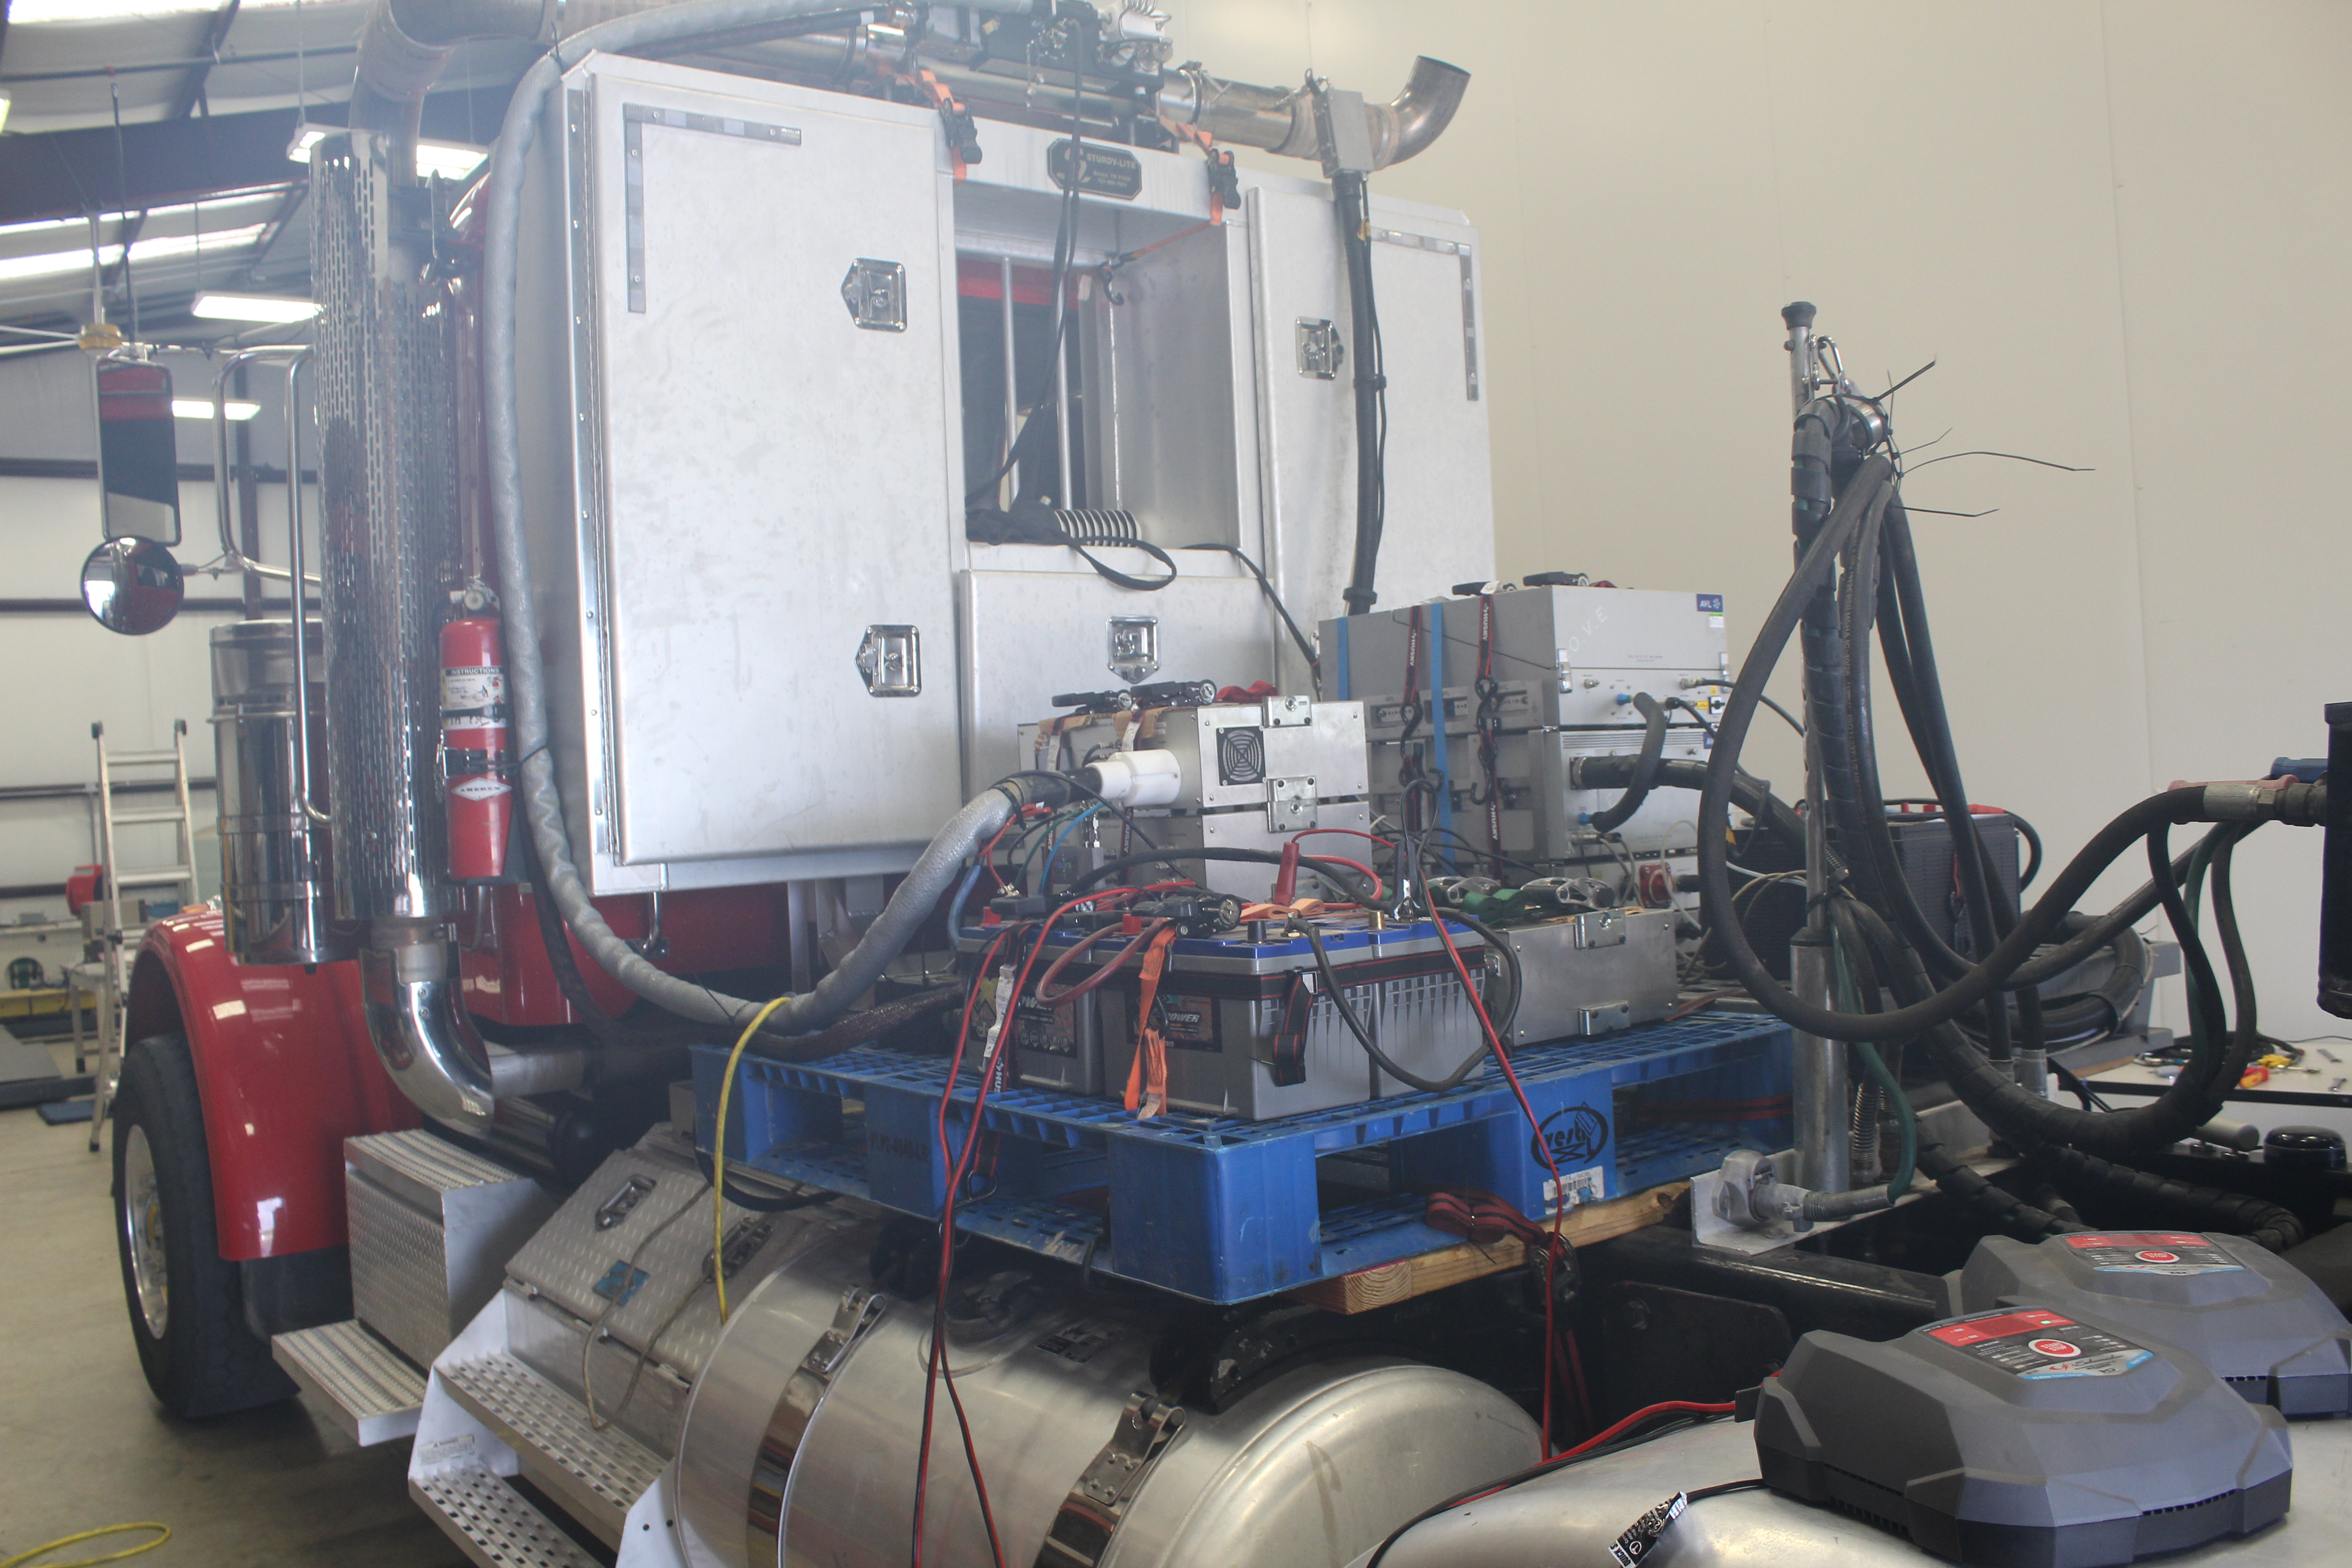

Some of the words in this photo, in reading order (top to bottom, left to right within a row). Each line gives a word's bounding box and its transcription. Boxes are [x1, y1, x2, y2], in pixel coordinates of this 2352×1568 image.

[1700, 600, 1712, 608] AVL
[451, 667, 499, 676] INSTRUCTIONS
[1490, 811, 1498, 840] HUSKY
[2040, 1341, 2062, 1349] START
[1616, 1548, 1632, 1567] QUICK
